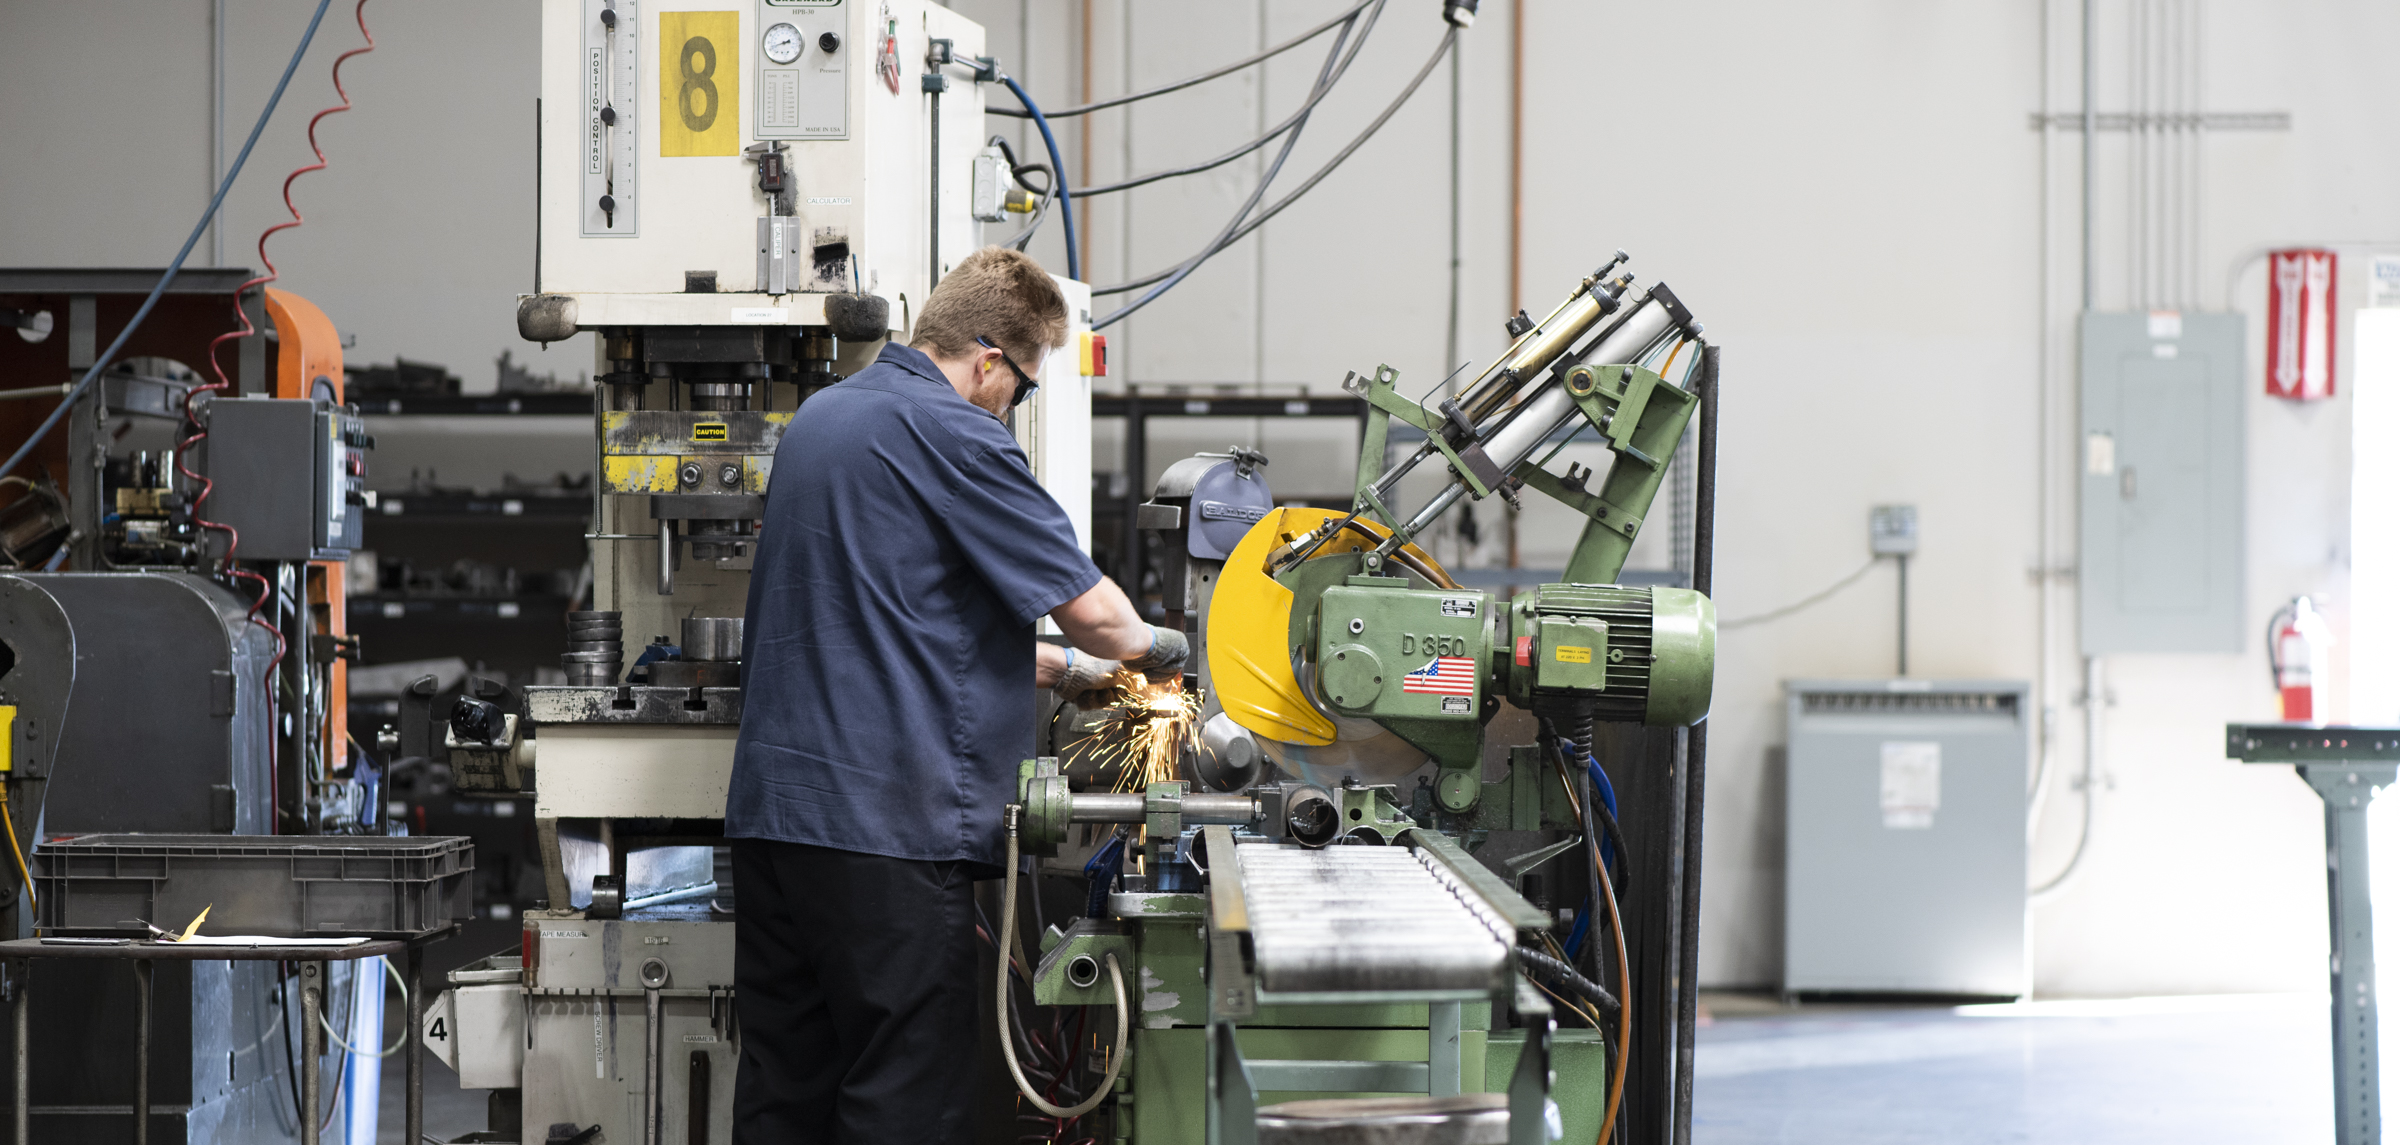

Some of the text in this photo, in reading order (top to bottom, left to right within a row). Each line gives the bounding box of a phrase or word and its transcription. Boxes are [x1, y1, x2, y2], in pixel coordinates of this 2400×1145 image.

[592, 53, 600, 112] POSITION
[679, 36, 718, 132] 8
[774, 226, 782, 256] CALIPER
[1403, 633, 1465, 657] D 350
[429, 1016, 448, 1041] 4
[594, 1011, 602, 1036] SCREW
